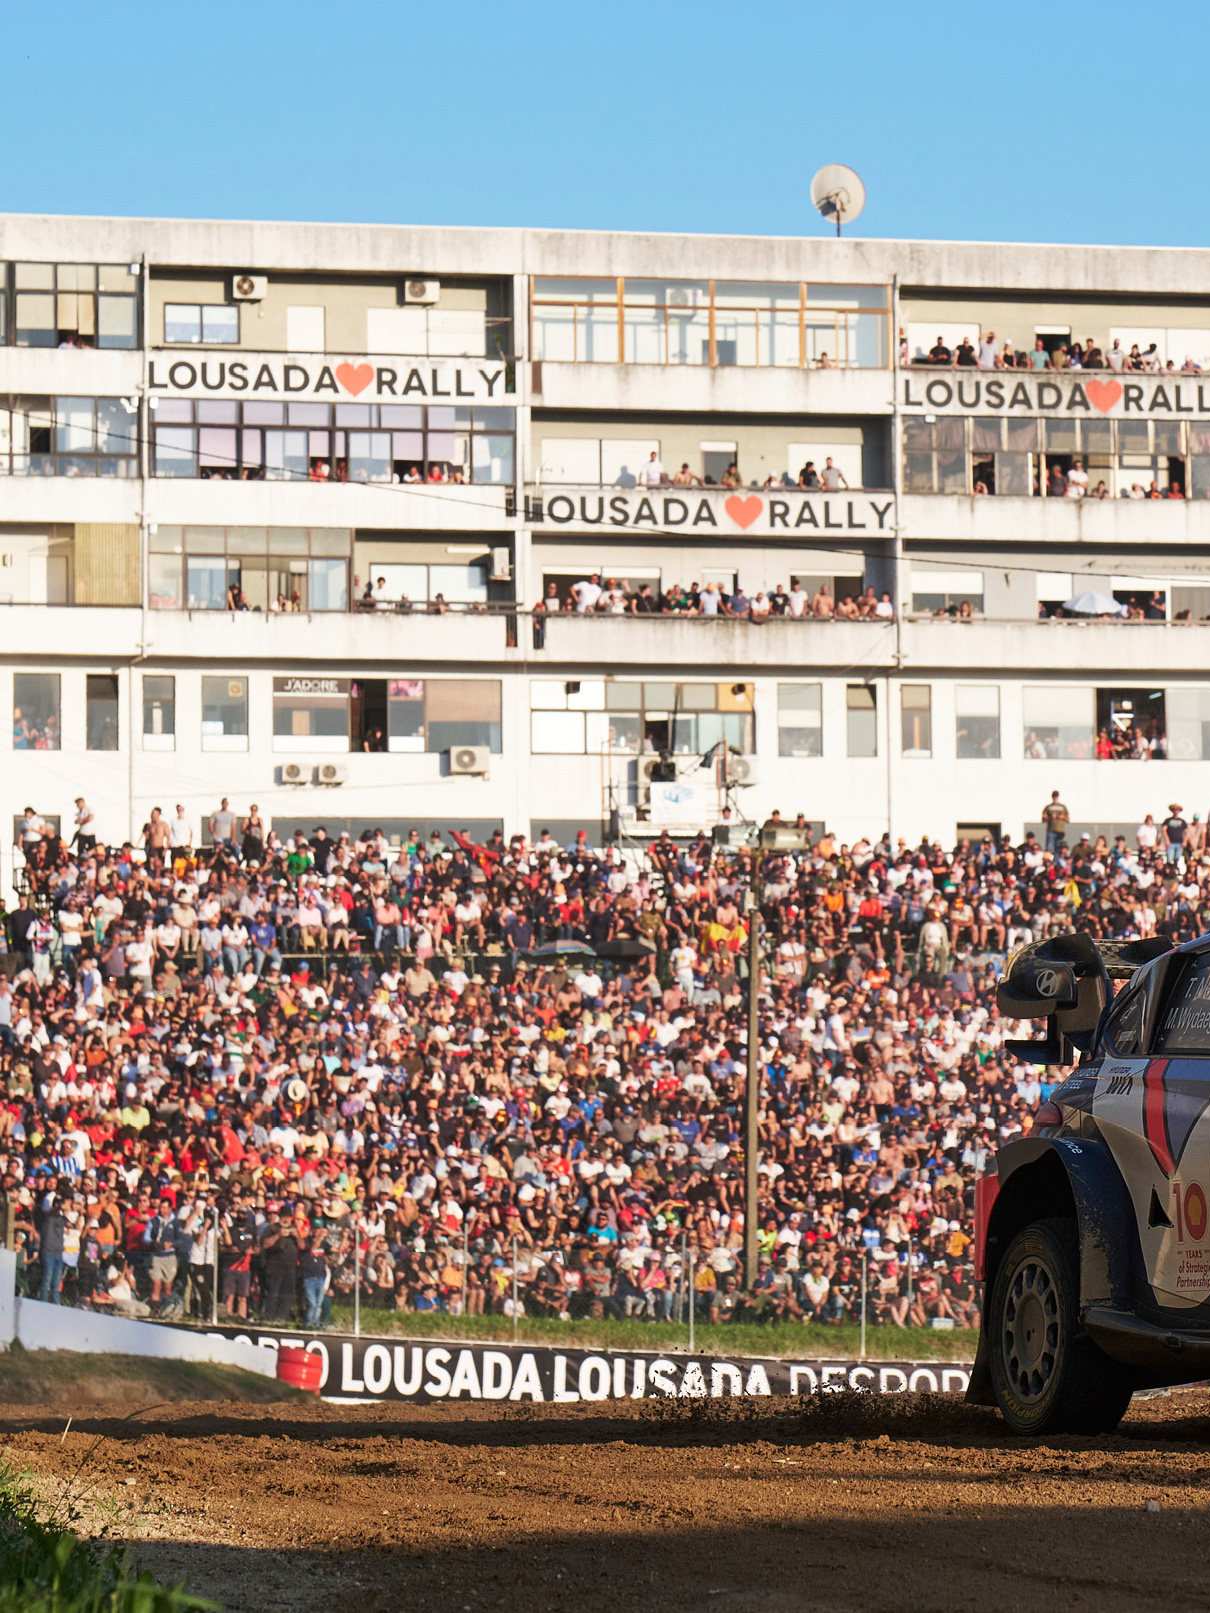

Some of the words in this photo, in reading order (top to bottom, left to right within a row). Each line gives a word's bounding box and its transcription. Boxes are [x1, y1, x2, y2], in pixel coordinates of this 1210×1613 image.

[149, 361, 340, 393] LOUSADA
[376, 367, 503, 397] RALLY
[904, 379, 1091, 410] LOUSADA
[770, 500, 894, 529] RALLY
[1185, 977, 1198, 998] T.
[1179, 1260, 1185, 1274] of
[1185, 1249, 1203, 1259] YEARS
[341, 1342, 545, 1402] LOUSADA
[553, 1354, 772, 1402] LOUSADA
